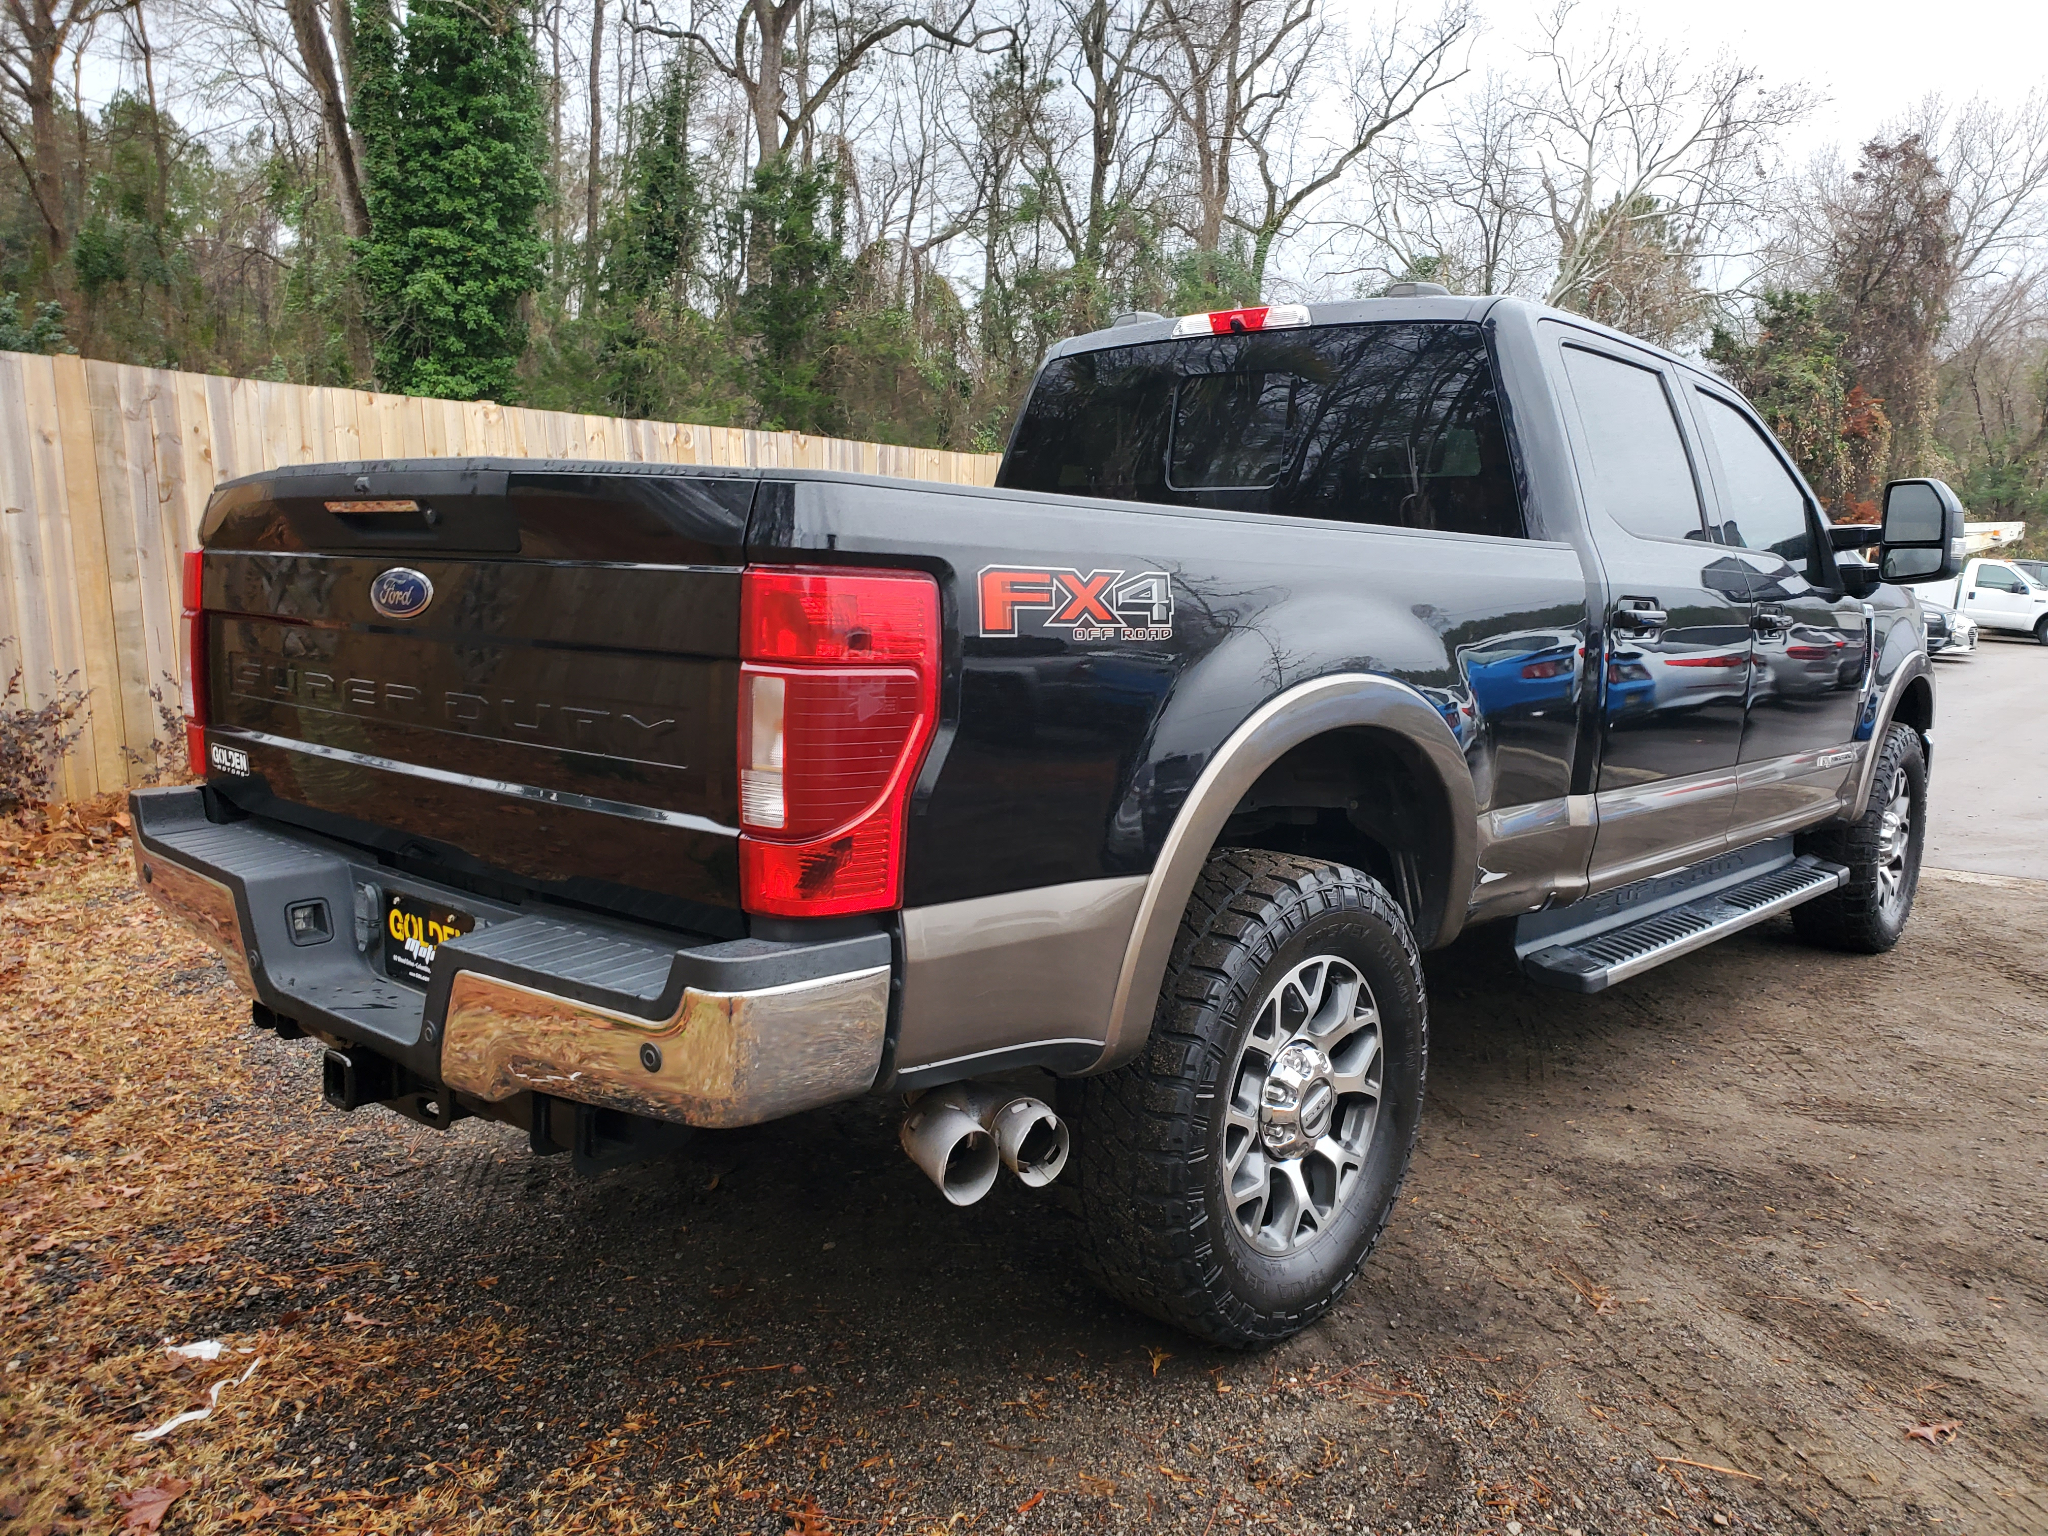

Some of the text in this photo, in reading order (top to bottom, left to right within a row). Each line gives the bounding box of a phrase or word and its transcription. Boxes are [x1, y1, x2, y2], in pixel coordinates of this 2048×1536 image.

[379, 577, 415, 606] Ford
[977, 564, 1174, 637] FX4
[1073, 627, 1173, 641] OFF ROAD
[235, 661, 423, 712] SUPER
[212, 746, 247, 771] GOLDEN
[389, 908, 461, 950] GOLDE
